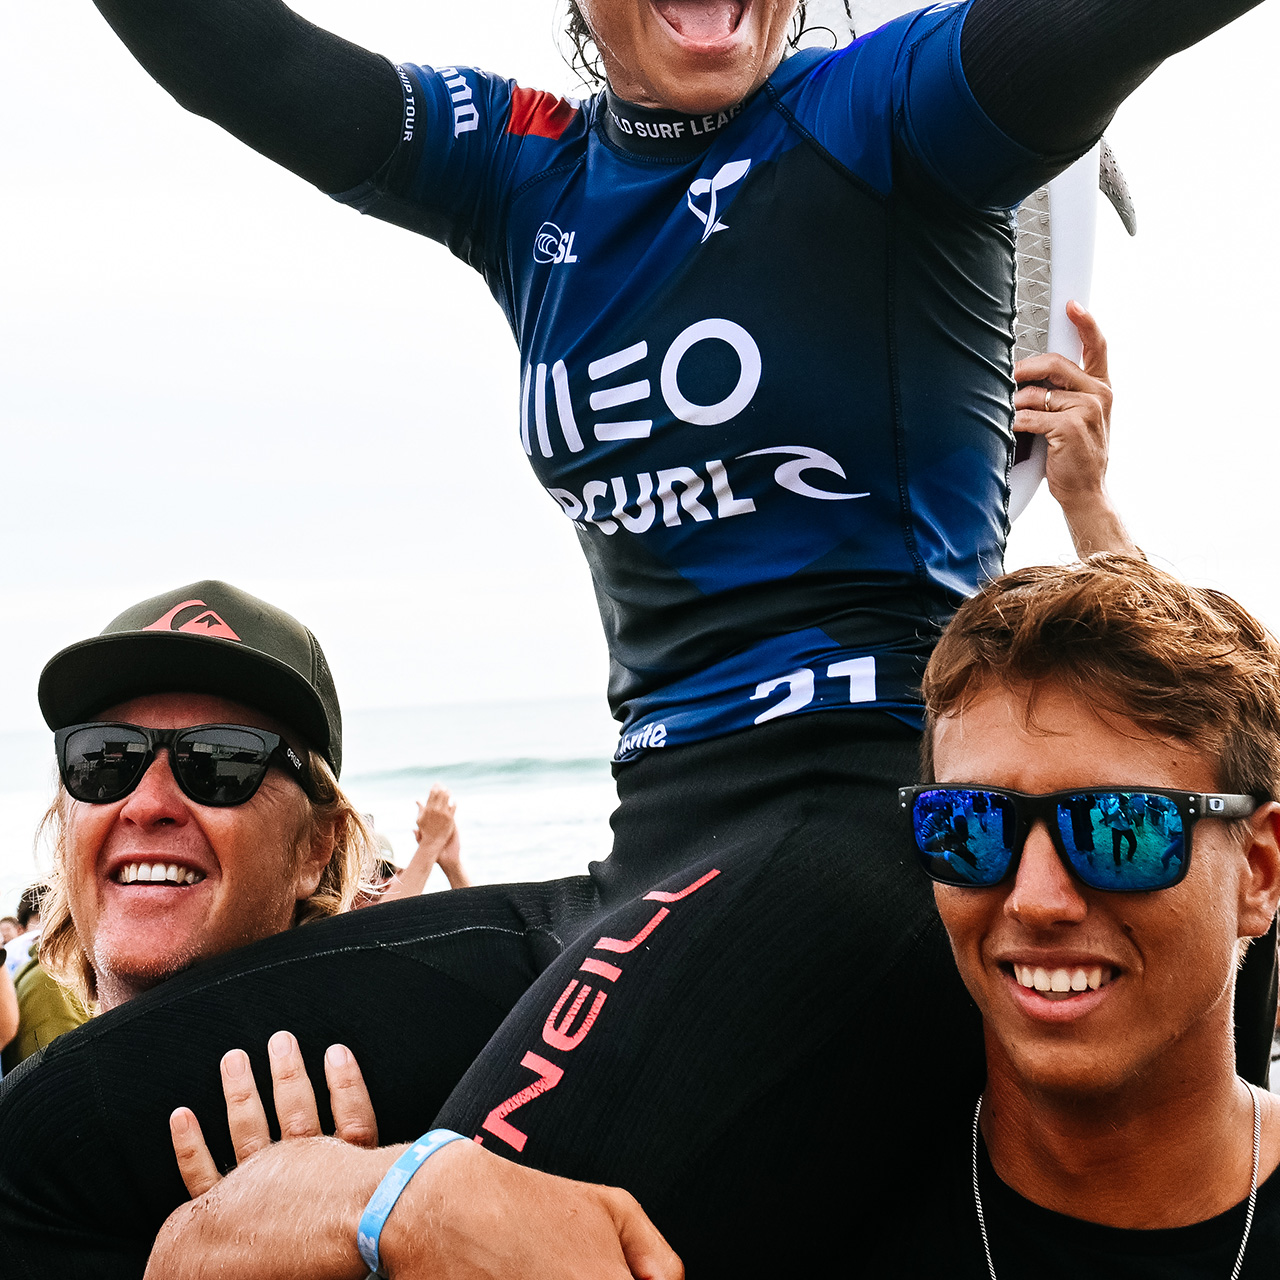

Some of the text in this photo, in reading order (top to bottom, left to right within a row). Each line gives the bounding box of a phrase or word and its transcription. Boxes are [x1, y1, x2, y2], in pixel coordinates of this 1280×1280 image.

[403, 96, 416, 142] TOUR
[634, 121, 685, 139] SURF
[749, 655, 877, 725] 21
